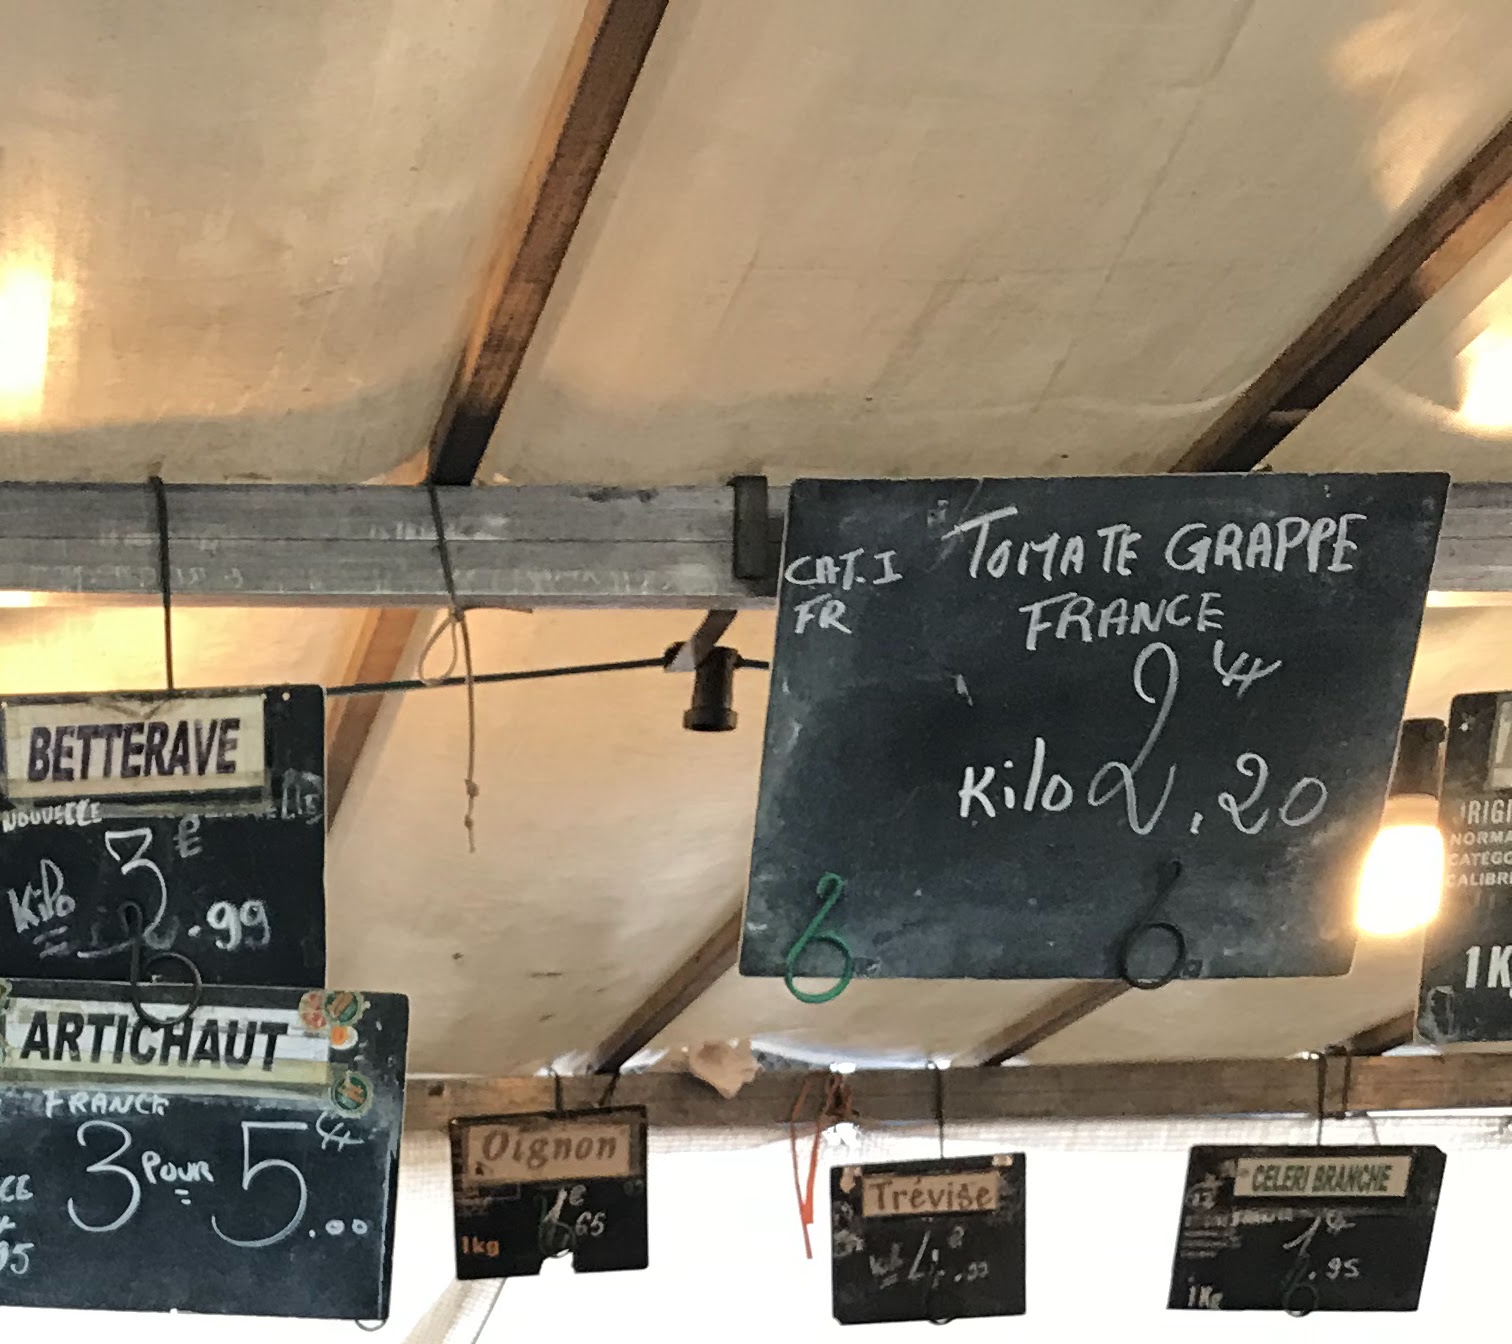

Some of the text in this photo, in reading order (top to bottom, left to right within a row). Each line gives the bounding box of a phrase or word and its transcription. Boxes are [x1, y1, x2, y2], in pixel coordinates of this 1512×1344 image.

[1164, 513, 1368, 575] GRAPPE
[793, 600, 853, 636] FR
[1018, 592, 1224, 651] FRANCE
[27, 717, 240, 783] BETTERAVE
[1447, 872, 1512, 889] CALIBR
[19, 1009, 288, 1073] ARTICHAUT
[66, 1119, 142, 1233] 3
[868, 1177, 993, 1212] Trévise
[1251, 1163, 1311, 1193] CELERI
[1310, 1163, 1393, 1194] BRANCHE
